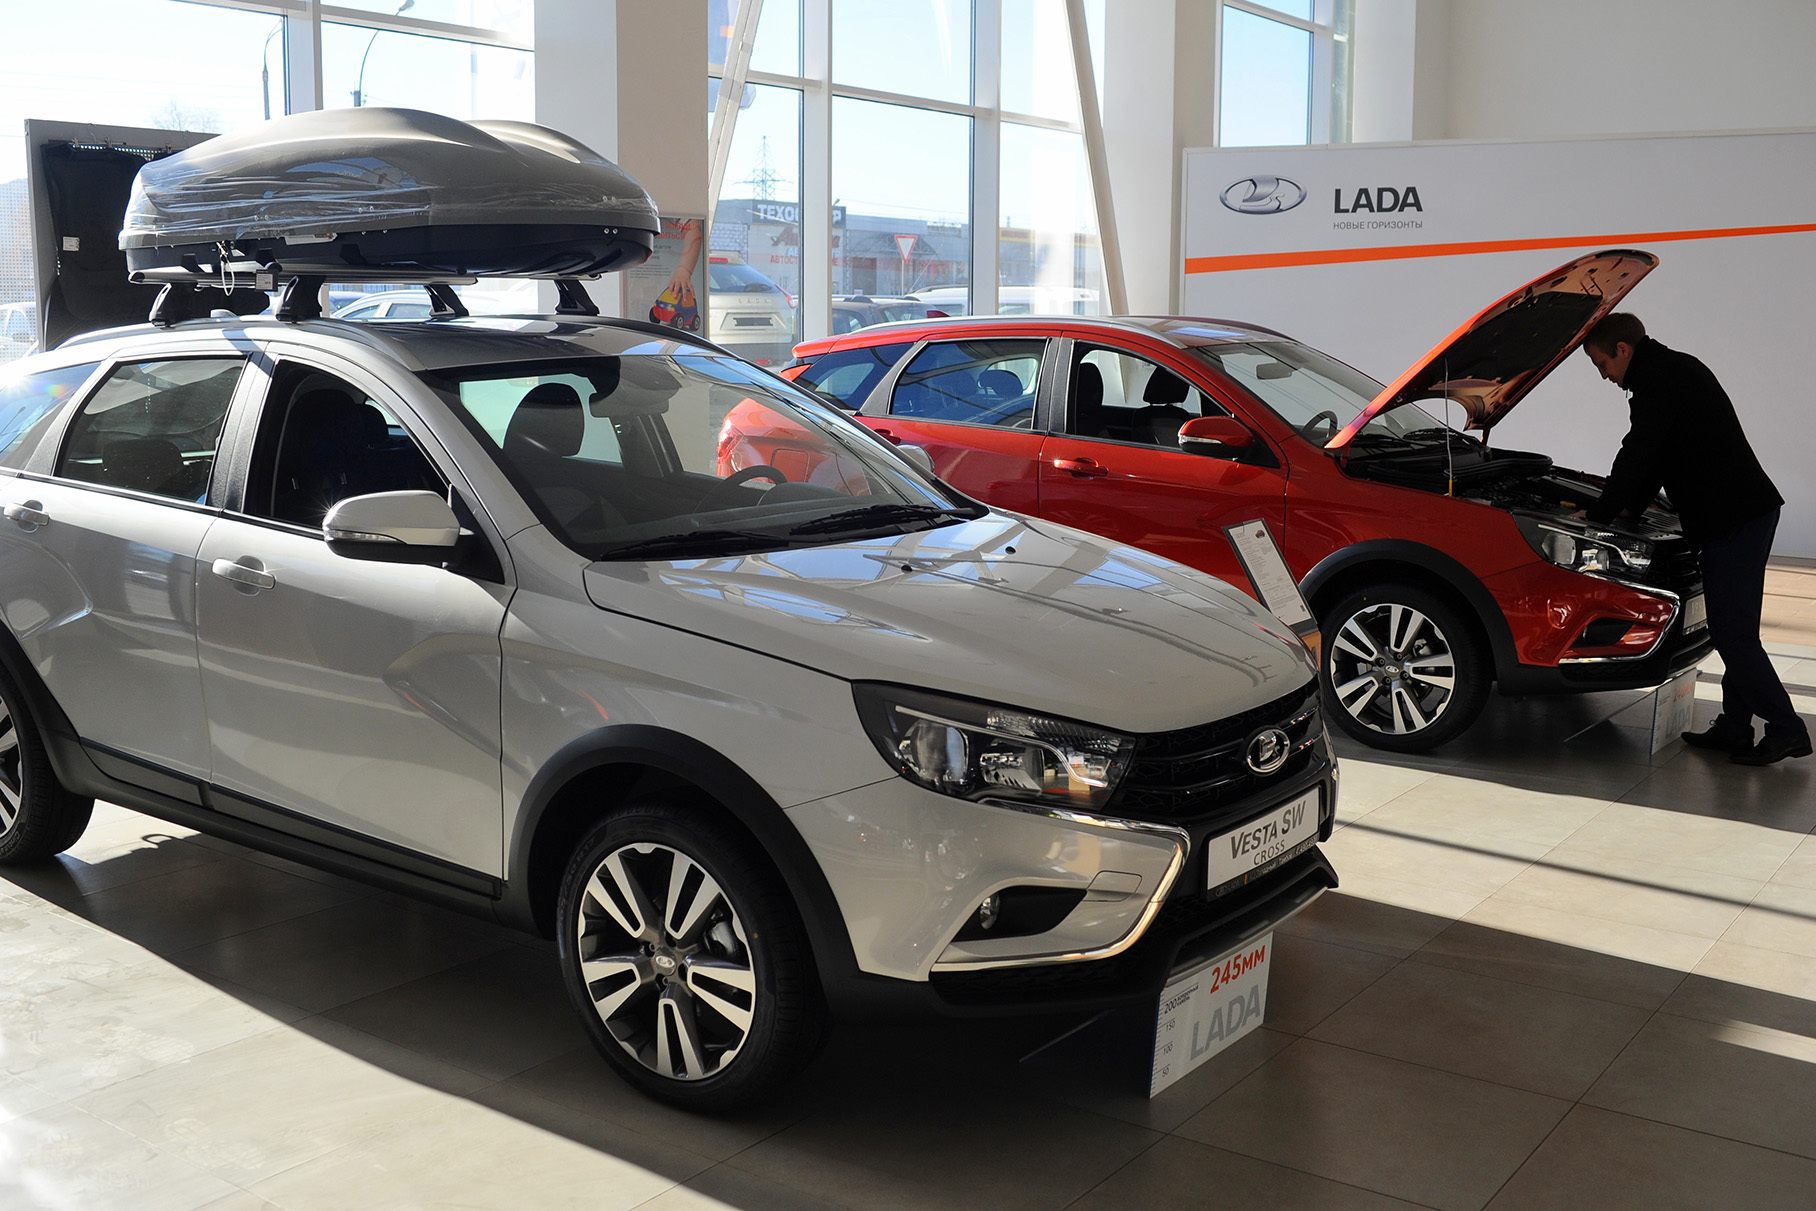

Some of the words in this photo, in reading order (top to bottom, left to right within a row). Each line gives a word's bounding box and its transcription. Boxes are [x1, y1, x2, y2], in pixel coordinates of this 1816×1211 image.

[1334, 186, 1424, 214] LADA
[1333, 221, 1365, 230] НОВЫЕ
[1367, 220, 1423, 230] ГОРИЗОНТЫ
[1230, 820, 1278, 860] VESTA
[1281, 800, 1306, 835] SW
[1253, 838, 1285, 866] CROSS
[1164, 998, 1177, 1014] 200
[1166, 1020, 1176, 1033] 150
[1191, 984, 1261, 1061] LADA
[1163, 1043, 1174, 1056] 100
[1162, 1067, 1170, 1078] 50
